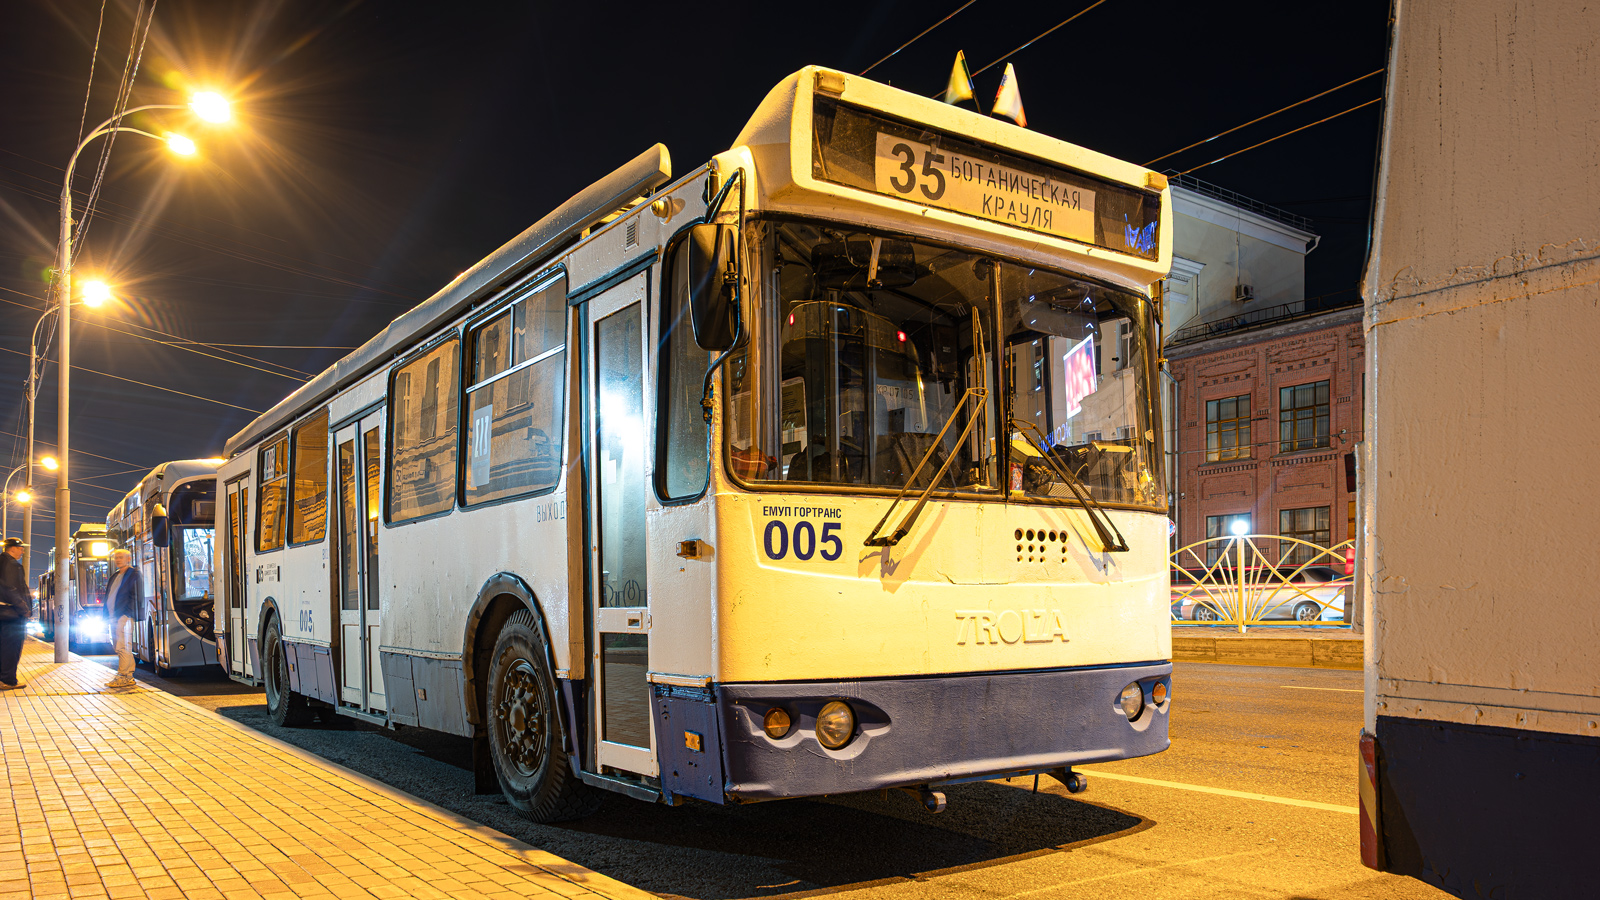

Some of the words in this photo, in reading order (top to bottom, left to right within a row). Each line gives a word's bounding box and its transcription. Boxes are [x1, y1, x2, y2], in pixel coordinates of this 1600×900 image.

[890, 143, 945, 201] 35
[951, 156, 1081, 212] БОТАНИЧЕСКАЯ
[982, 194, 1053, 230] КРАУЛЯ
[536, 500, 566, 523] ВЫХОД
[762, 505, 791, 518] ЕМУП
[793, 506, 842, 519] ГОРТРАНС
[763, 520, 844, 562] 005
[299, 609, 313, 633] 005
[955, 608, 1071, 646] TROLZA
